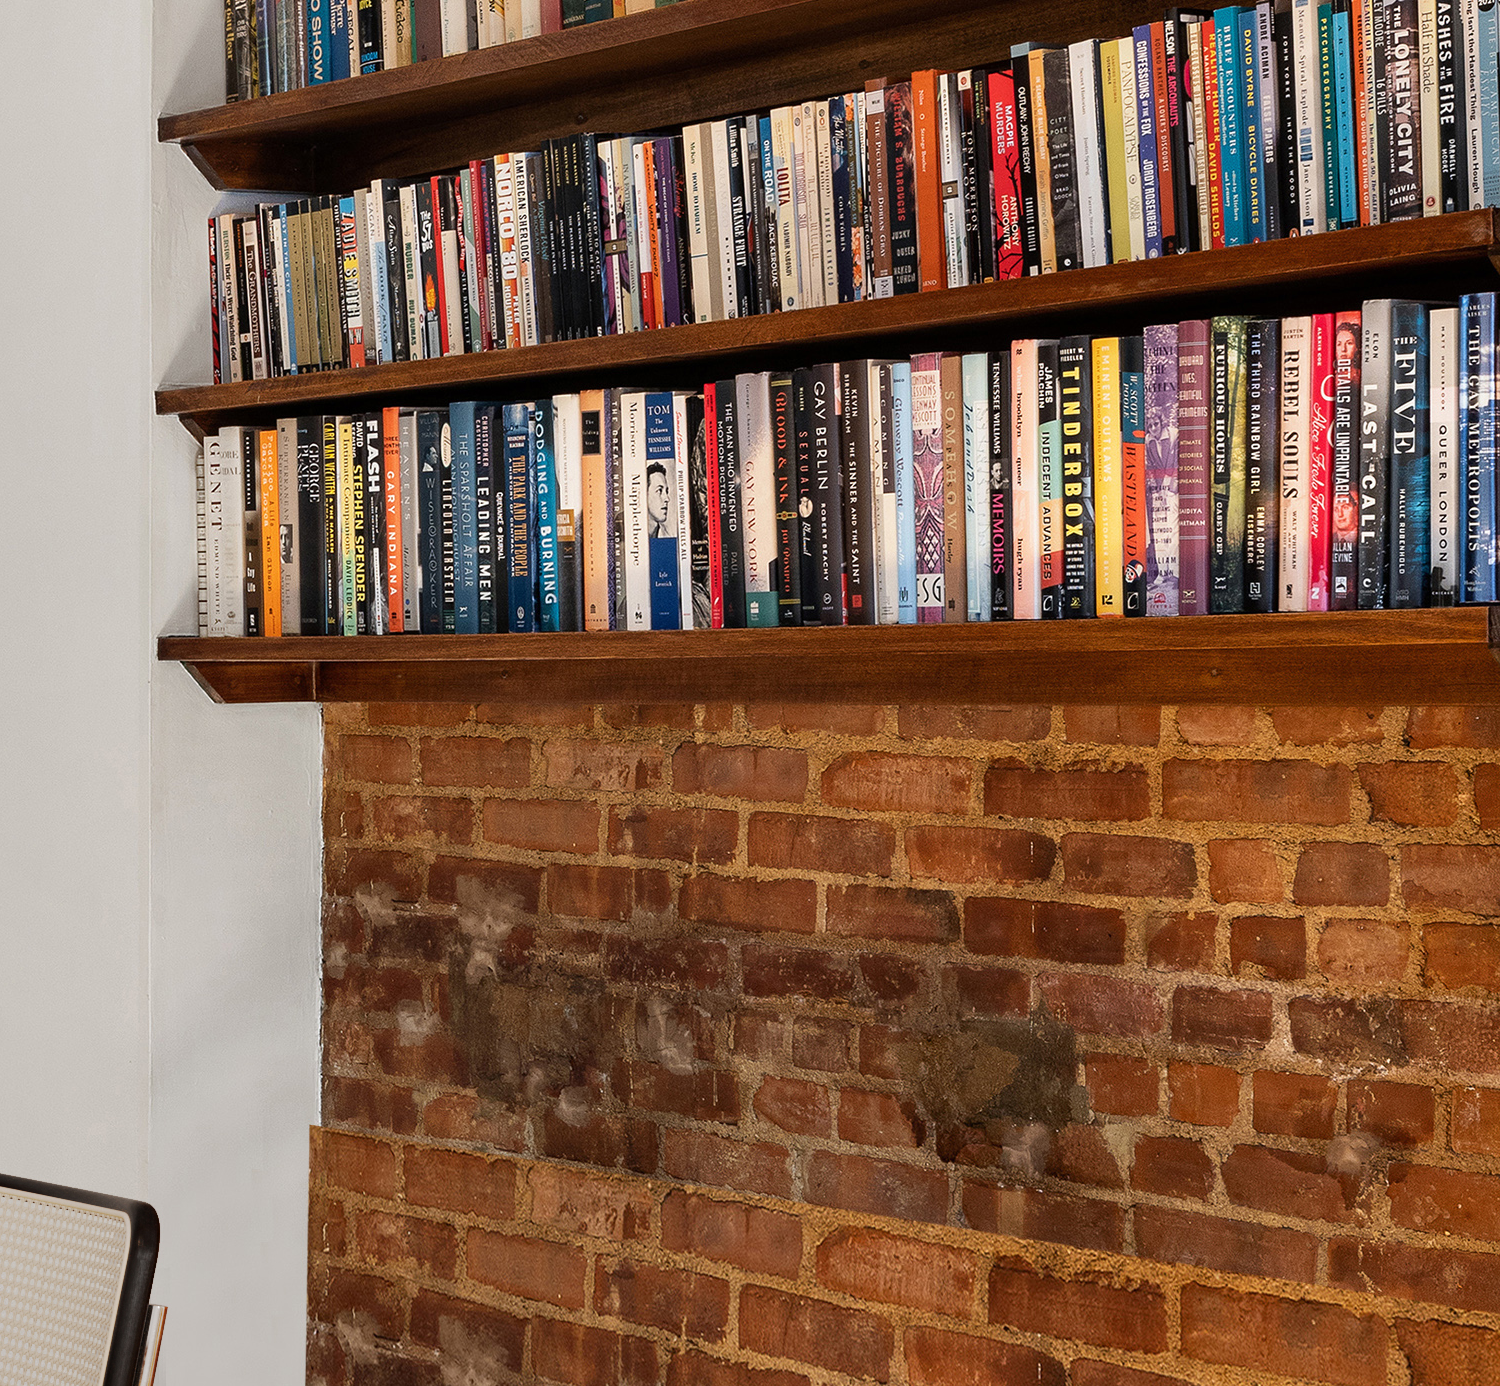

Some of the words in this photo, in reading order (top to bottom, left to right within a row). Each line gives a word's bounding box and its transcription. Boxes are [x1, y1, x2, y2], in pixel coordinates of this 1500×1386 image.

[311, 19, 323, 80] SHOW
[1165, 20, 1175, 55] NELSON
[1422, 11, 1433, 39] Half
[1422, 43, 1433, 55] in
[1437, 3, 1452, 62] ASHES
[1136, 41, 1150, 99] CONFESSIONS
[1166, 56, 1175, 73] THE
[1209, 33, 1217, 88] REALITY
[1394, 30, 1411, 115] LONELY
[1422, 56, 1434, 93] Shade
[1167, 73, 1178, 127] ARGONAUTS
[1246, 69, 1254, 107] BYRNE
[995, 102, 1005, 154] MURDERS
[1004, 105, 1014, 148] MAGPIE
[1141, 117, 1152, 136] FOX
[1212, 90, 1220, 142] HUNGER
[764, 139, 769, 150] ON
[1208, 143, 1217, 181] DAVID
[1248, 125, 1256, 173] BICYCLE
[1396, 123, 1413, 176] CITY
[515, 159, 527, 210] AMERICAN
[765, 171, 774, 202] ROAD
[776, 167, 790, 207] LOLITA
[1143, 159, 1154, 186] JORDY
[496, 165, 515, 239] NORCO
[1001, 195, 1012, 250] HOROWITZ
[1009, 196, 1019, 246] ANTHONY
[1145, 187, 1157, 238] ROSENBERG
[1211, 187, 1220, 237] SHIELDS
[1250, 178, 1259, 224] DIARIES
[341, 211, 357, 264] ZADIE
[518, 214, 530, 263] SHERLOCK
[770, 245, 778, 287] KEROUAC
[345, 268, 361, 318] SMITH
[1252, 333, 1260, 357] THE
[1468, 326, 1480, 365] THE
[813, 381, 826, 420] GAY
[1214, 345, 1226, 414] FURIOUS
[1251, 363, 1260, 399] THIRD
[1284, 349, 1300, 422] REBEL
[1337, 359, 1350, 403] DETAILS
[1393, 350, 1417, 455] FIVE
[1468, 375, 1480, 409] GAY
[648, 406, 670, 415] TOM
[1252, 405, 1260, 461] RAINBOW
[1337, 406, 1350, 428] ARE
[1362, 384, 1378, 452] LAST
[366, 420, 380, 493] FLASH
[535, 410, 548, 494] DODGING
[815, 427, 829, 489] BERLIN
[1041, 432, 1051, 500] INDECENT
[1063, 367, 1083, 537] TINDERBOX
[1214, 416, 1226, 473] HOURS
[1282, 431, 1299, 499] SOULS
[1336, 431, 1350, 504] UNPRINTABLE
[1438, 425, 1447, 480] QUEER
[209, 442, 222, 530] GENET
[353, 465, 363, 529] STEPHEN
[387, 471, 395, 514] GARY
[718, 464, 726, 515] PICTURES
[728, 479, 737, 532] INVENTED
[1124, 445, 1136, 557] WASTELAND
[1251, 466, 1260, 495] GIRL
[1467, 423, 1481, 552] METROPOLIS
[477, 477, 490, 554] LEADING
[630, 474, 641, 567] Mapplethorpe
[992, 494, 1005, 574] MEMOIRS
[1361, 474, 1376, 543] CALL
[1438, 491, 1447, 562] LONDON
[354, 536, 365, 602] SPENDER
[388, 525, 398, 596] INDIANA
[540, 526, 557, 604] BURNING
[1041, 507, 1052, 581] ADVANCES
[479, 565, 491, 601] MEN
